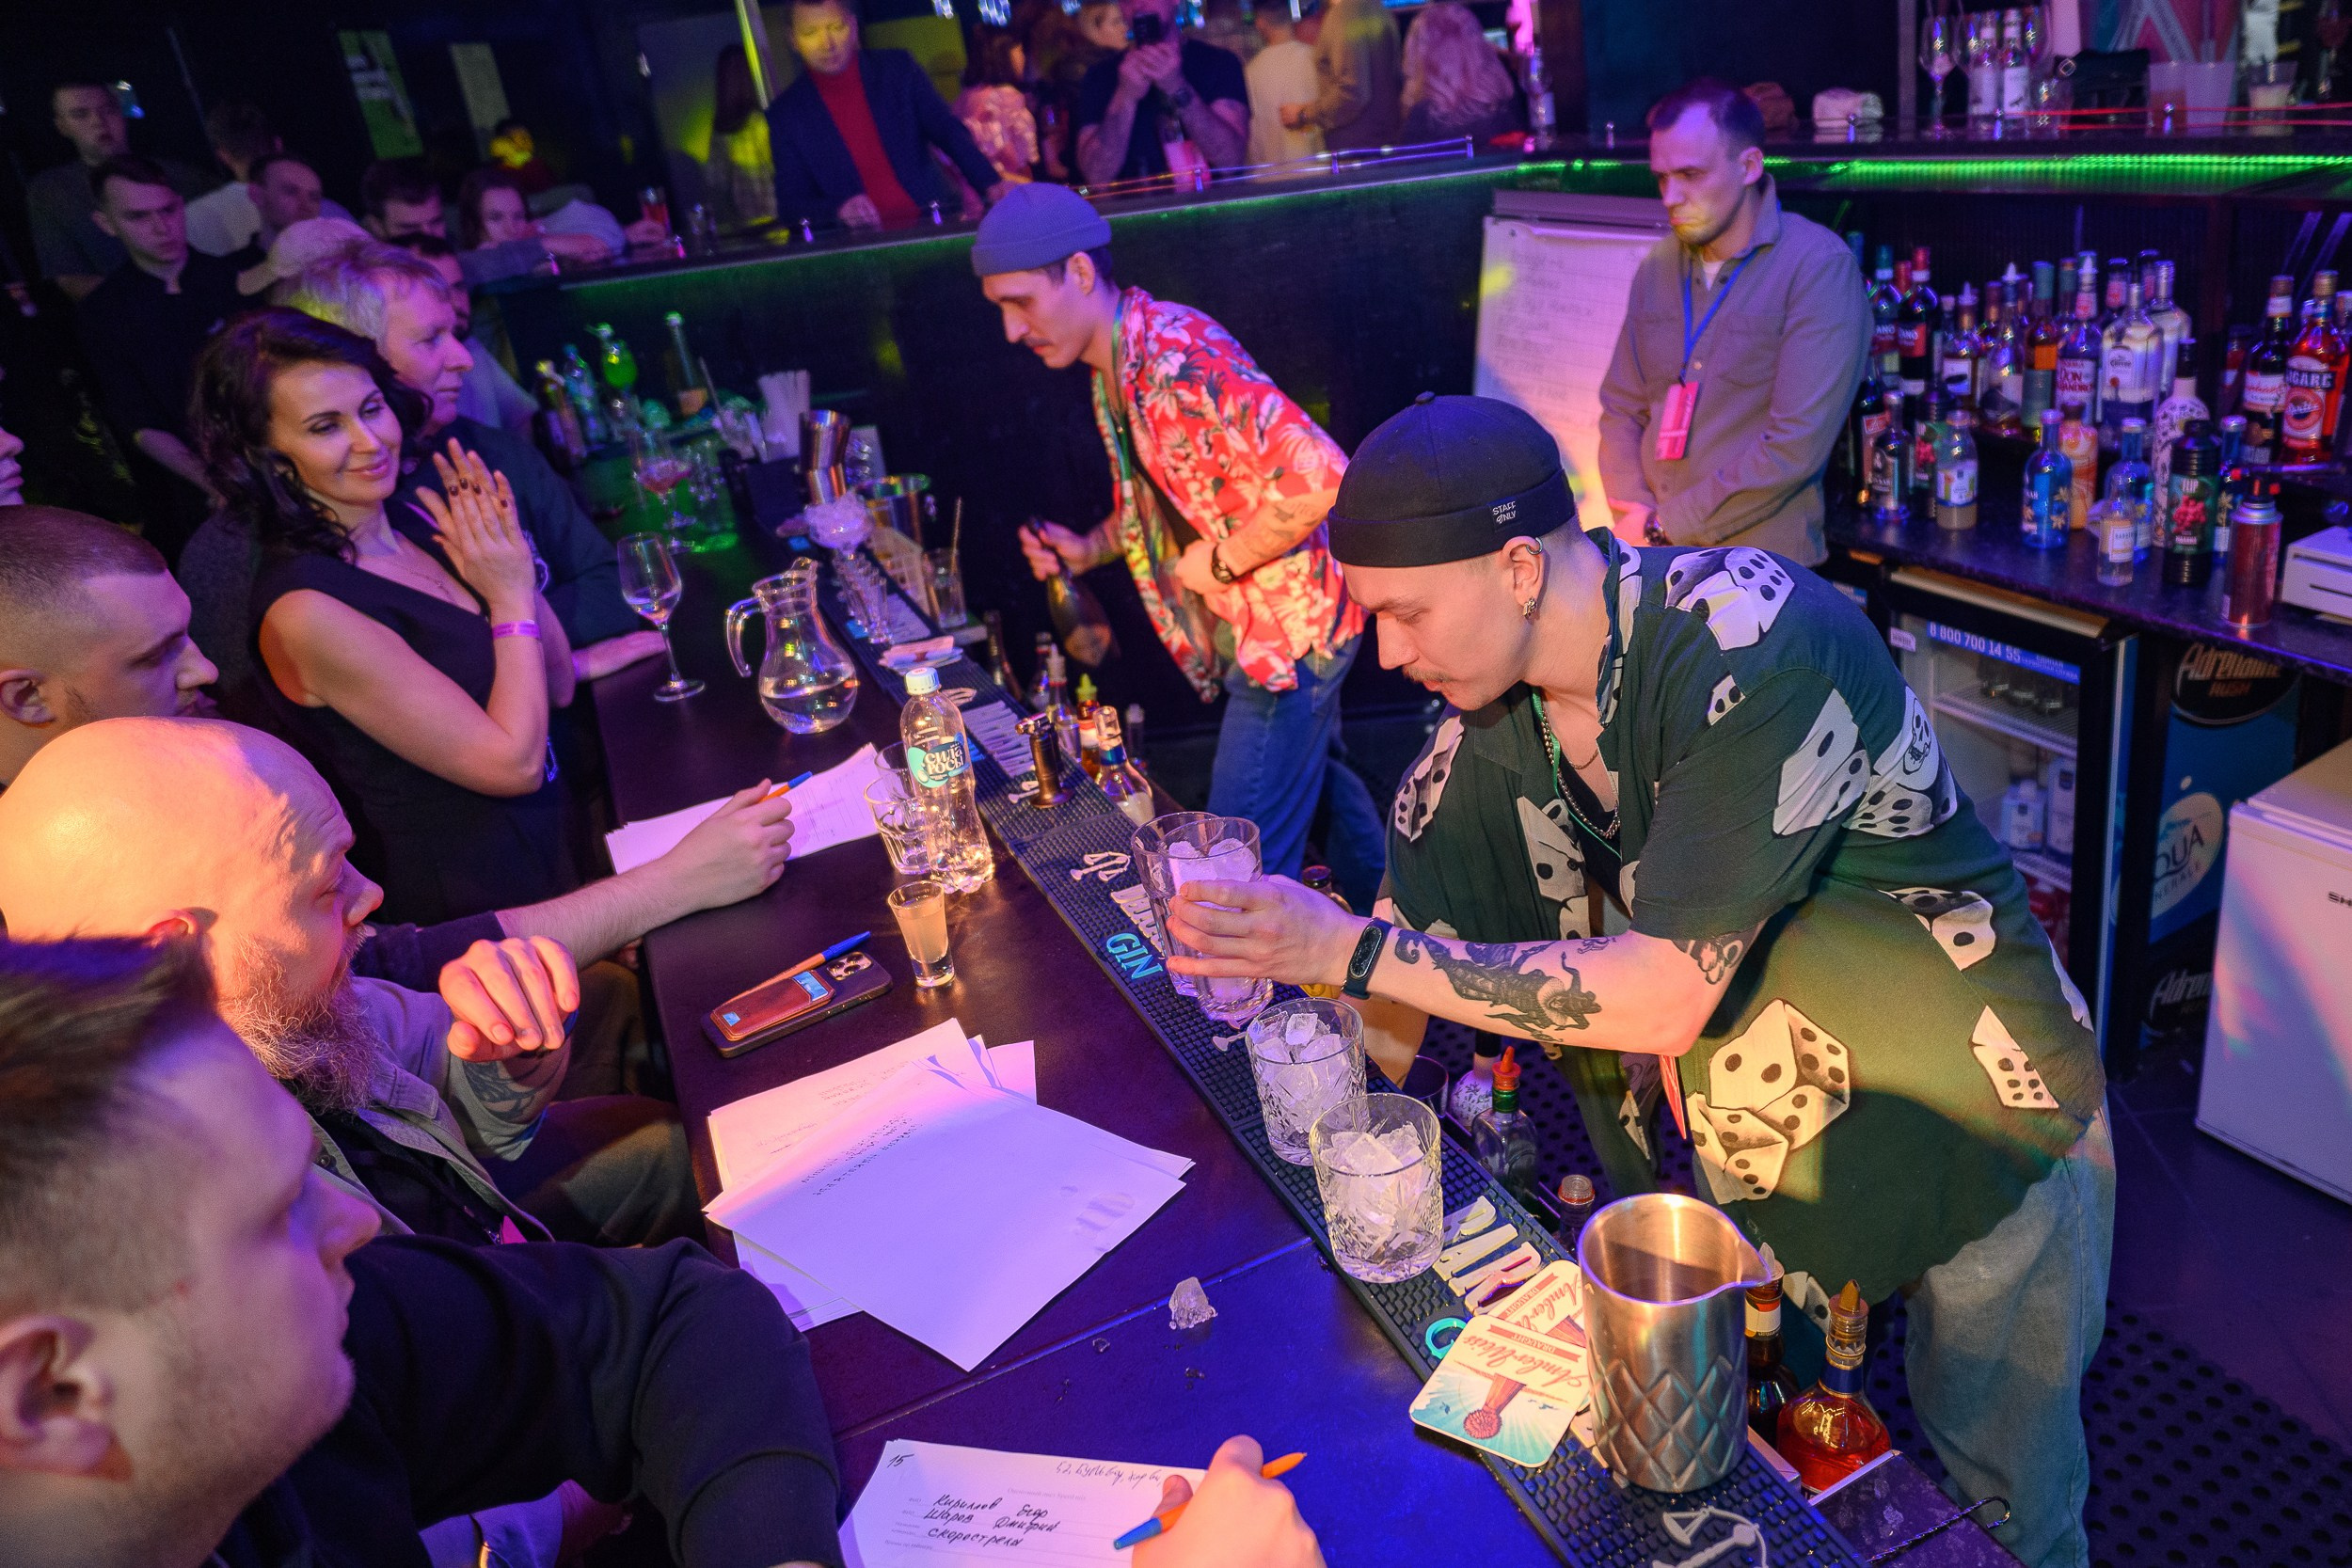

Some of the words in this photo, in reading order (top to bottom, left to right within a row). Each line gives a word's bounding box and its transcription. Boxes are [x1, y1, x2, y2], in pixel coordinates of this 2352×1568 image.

[1492, 501, 1517, 515] STAFF
[1496, 510, 1517, 524] ONLY
[1930, 621, 1937, 638] 8
[1939, 625, 1962, 645] 800
[1964, 632, 1986, 653] 700
[1988, 640, 2003, 657] 14
[2005, 644, 2022, 663] 55
[1106, 932, 1163, 979] GIN
[1505, 1287, 1541, 1316] DRAUGHT
[1511, 1333, 1556, 1354] DRAUGHT
[887, 1453, 914, 1468] 15
[933, 1494, 1003, 1514] Кириллов
[1016, 1504, 1048, 1521] Егор
[923, 1508, 974, 1526] Шаров
[993, 1516, 1060, 1535] Дмитрий
